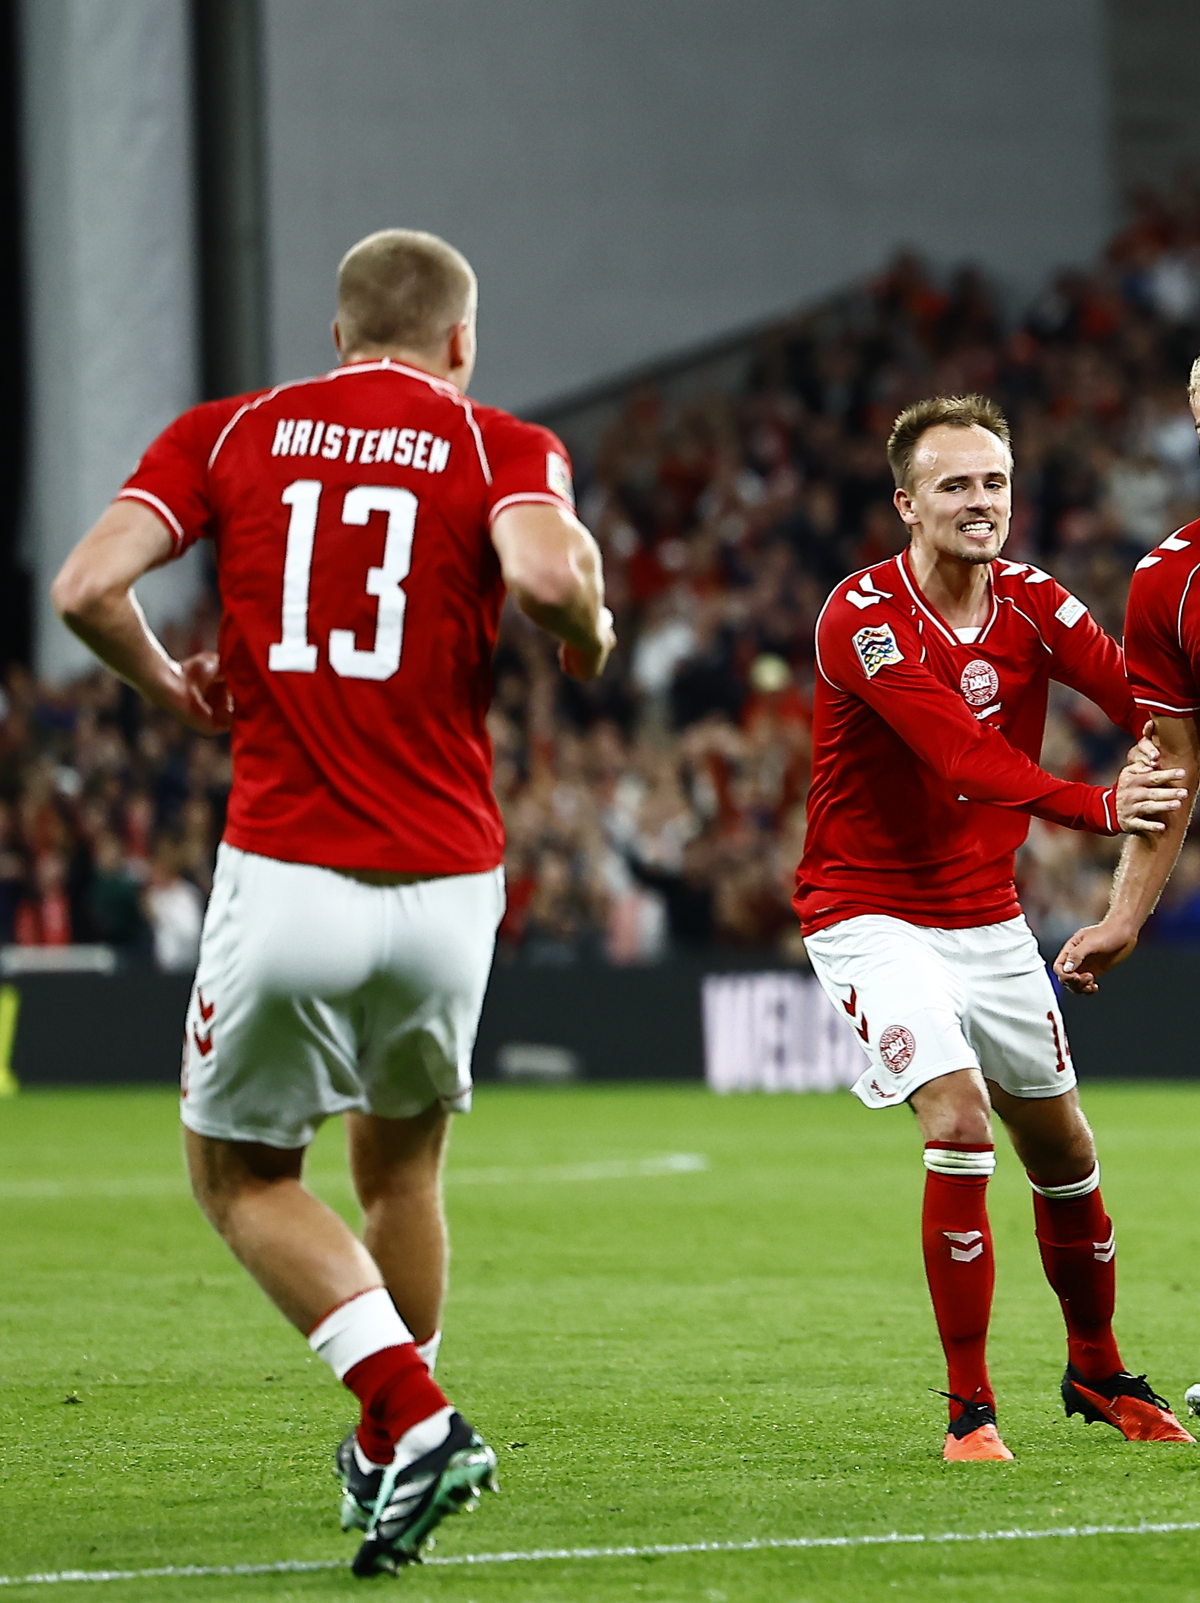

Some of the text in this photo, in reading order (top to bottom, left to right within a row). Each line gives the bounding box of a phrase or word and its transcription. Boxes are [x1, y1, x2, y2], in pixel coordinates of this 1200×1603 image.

[271, 418, 451, 474] KRISTENSEN
[268, 478, 419, 682] 13
[968, 673, 992, 691] DBU
